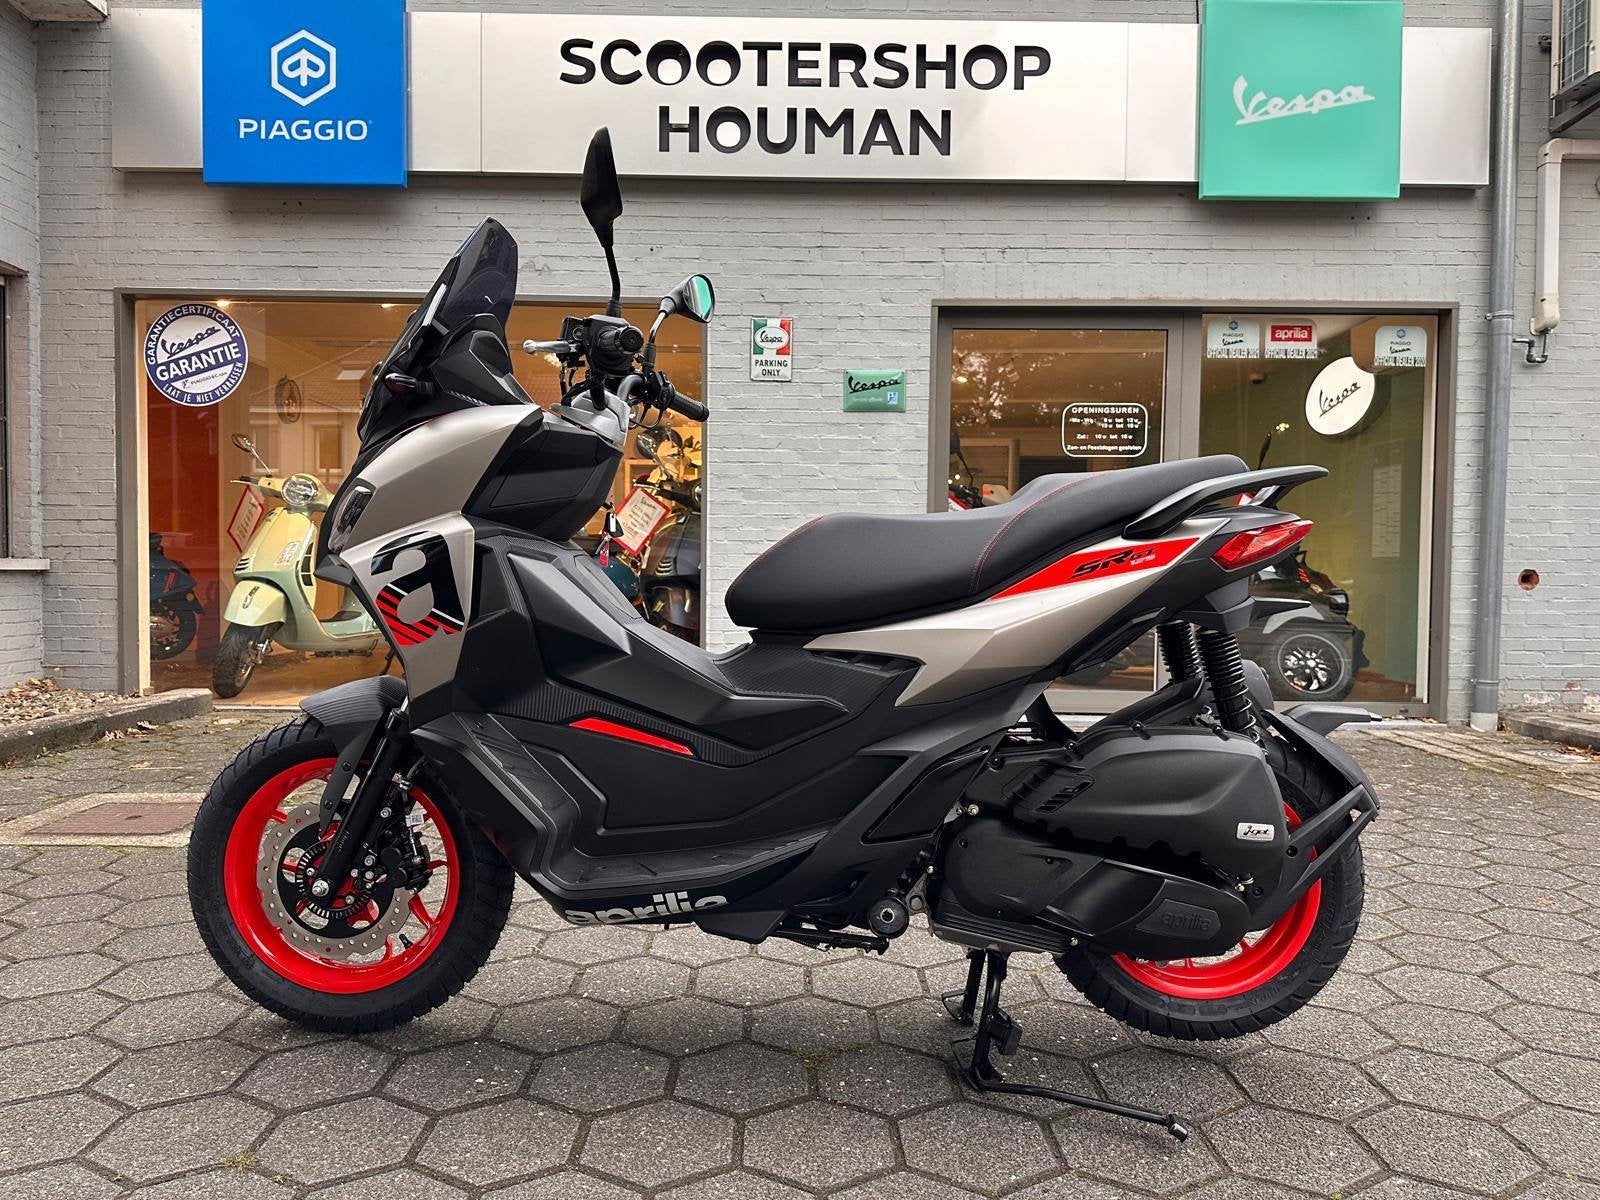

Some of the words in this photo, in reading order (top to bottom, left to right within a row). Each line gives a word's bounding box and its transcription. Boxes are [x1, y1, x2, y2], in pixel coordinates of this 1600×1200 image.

[559, 38, 1051, 91] SCOOTERSHOP
[1232, 74, 1376, 126] Vespa
[238, 118, 368, 141] PIAGGIO
[658, 105, 952, 157] HOUMAN
[147, 305, 240, 365] GARANTIECERTIFICAAT
[160, 326, 221, 360] Vespa
[760, 330, 784, 344] Vespa
[1275, 327, 1308, 340] aprilia
[156, 342, 242, 382] GARANTIE
[754, 359, 788, 368] PARKING
[761, 368, 781, 376] ONLY
[162, 383, 180, 399] LAAT
[183, 394, 192, 403] JE
[196, 393, 214, 403] NIET
[214, 361, 244, 397] VERRASSEN
[848, 375, 901, 394] Vespa
[1319, 382, 1361, 418] Vespa
[1068, 549, 1134, 580] SR
[1162, 911, 1212, 931] aprilia
